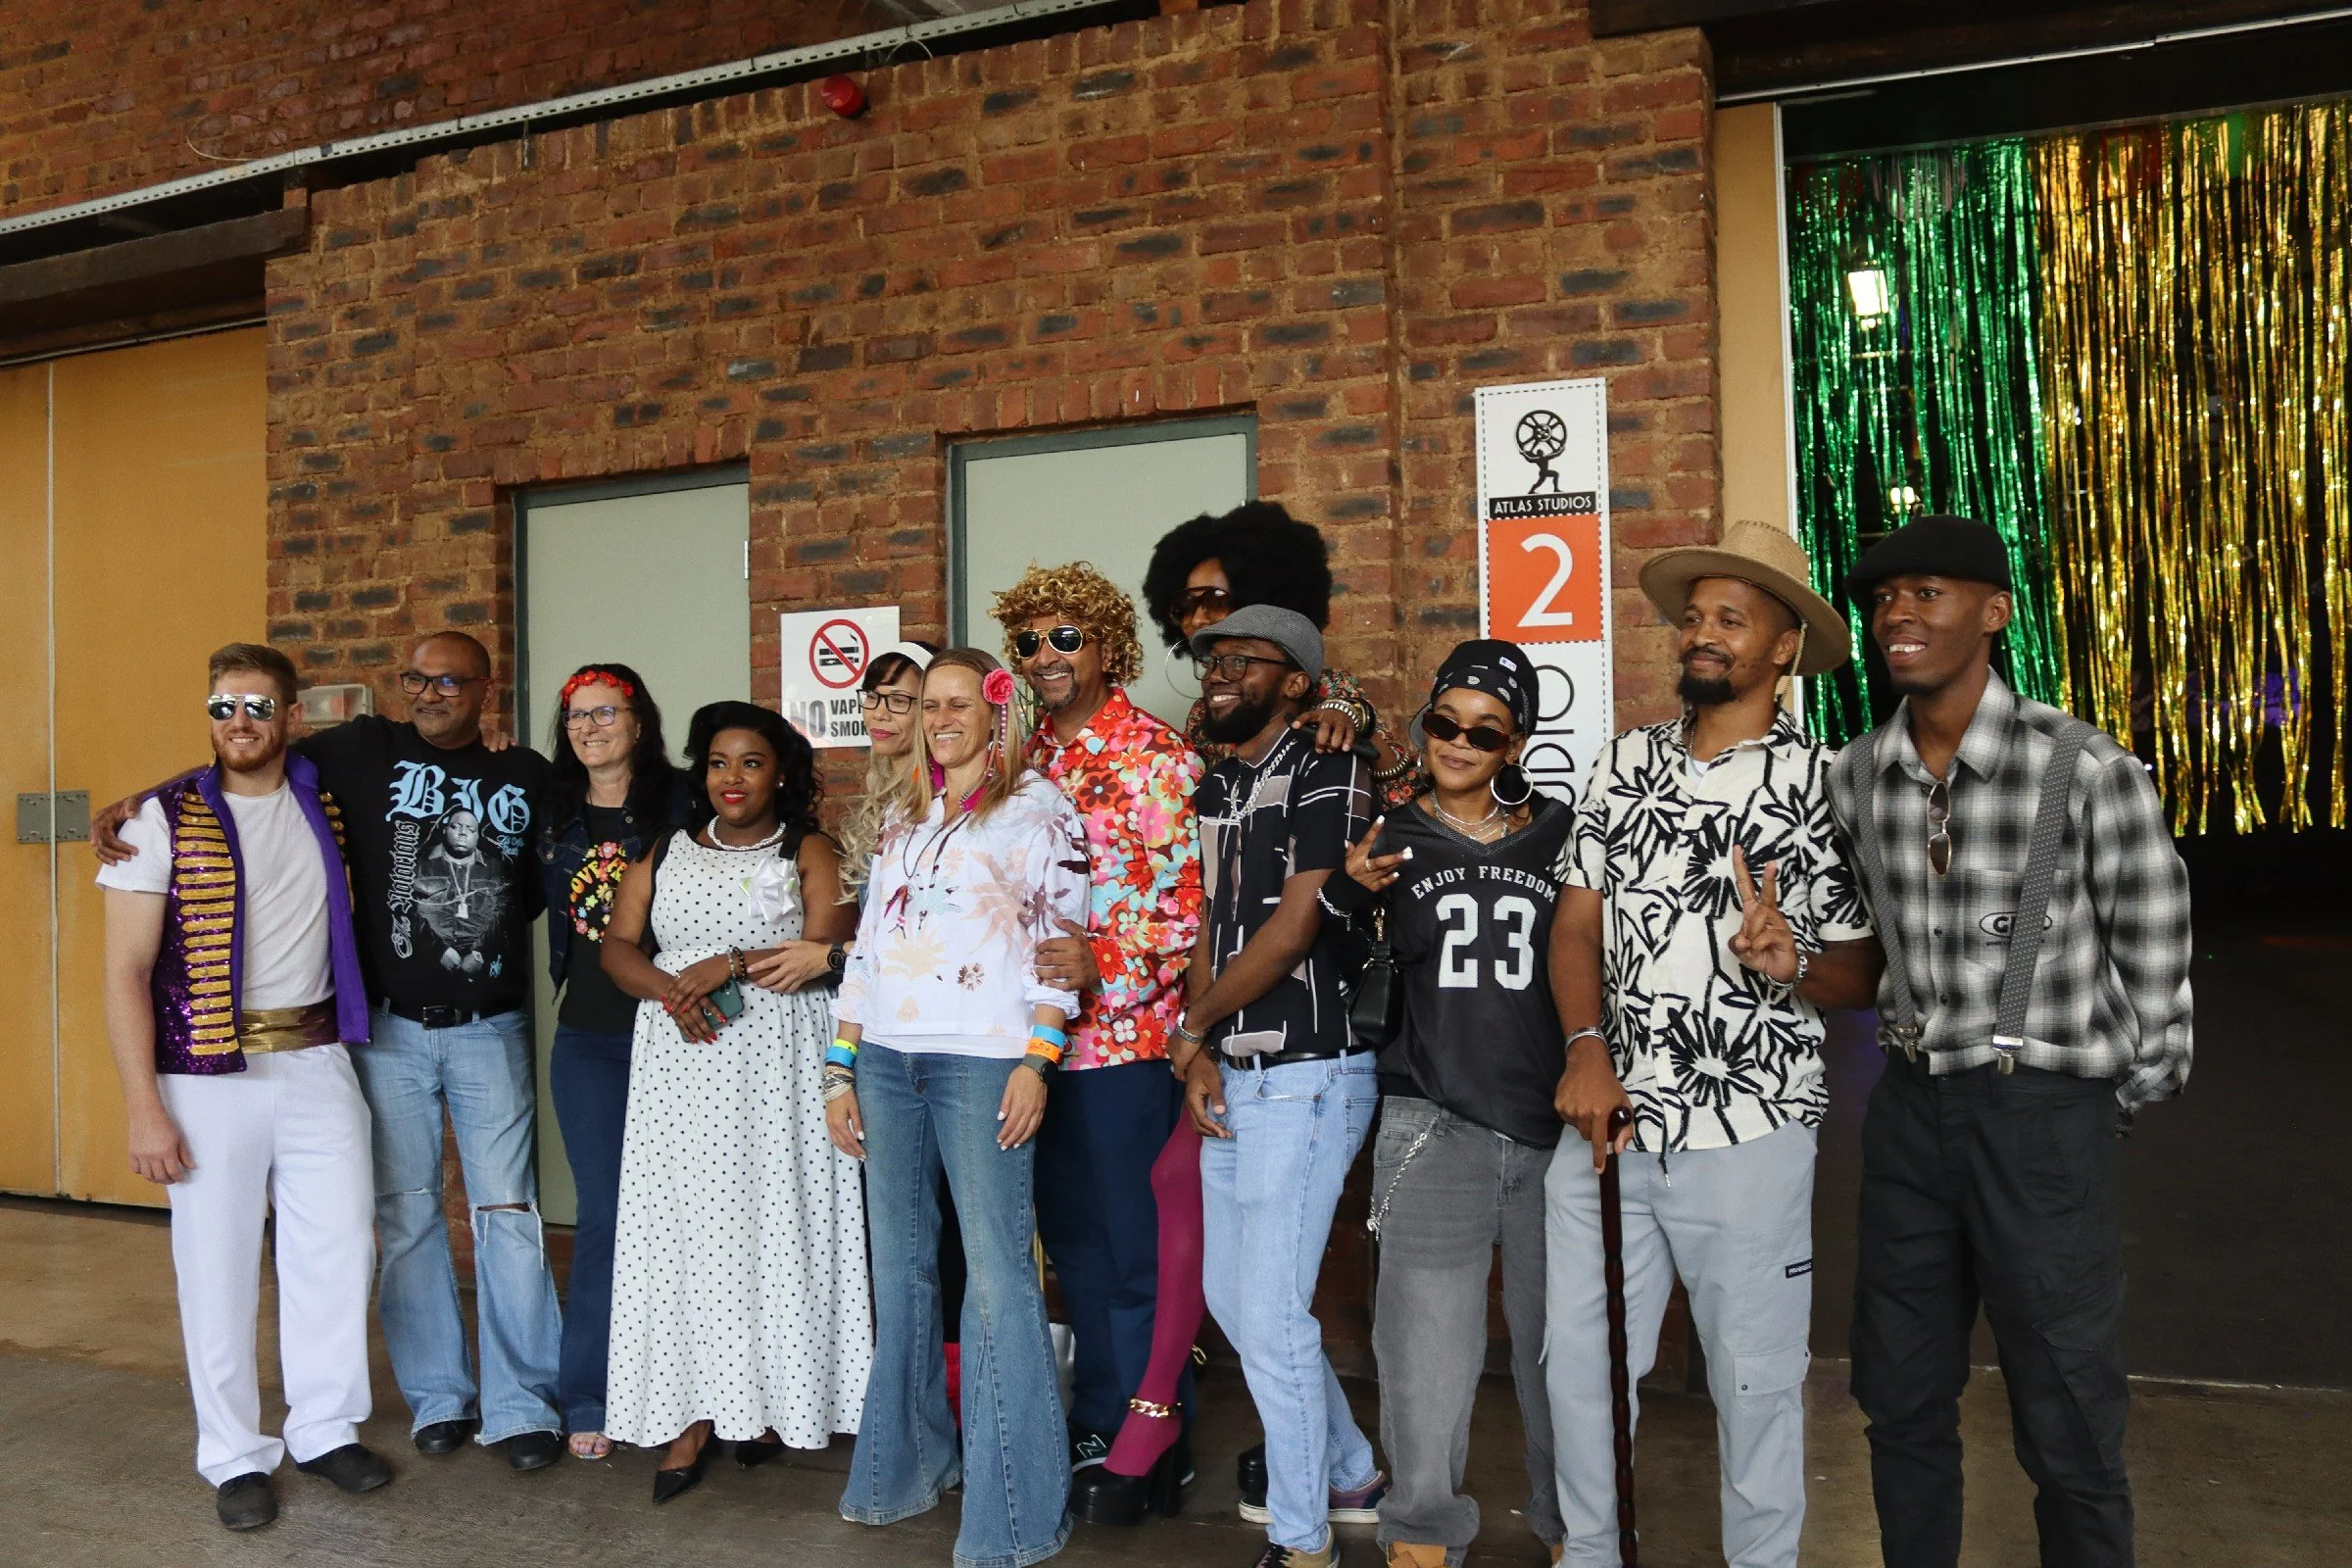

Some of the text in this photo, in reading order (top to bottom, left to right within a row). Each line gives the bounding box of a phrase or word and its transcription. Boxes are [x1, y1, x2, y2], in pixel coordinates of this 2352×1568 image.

[1494, 495, 1592, 514] ATLAS STUDIOS
[1516, 532, 1574, 628] 2
[385, 760, 531, 834] BIG
[1410, 865, 1557, 904] ENJOY FREEDOM
[1436, 893, 1538, 991] 23
